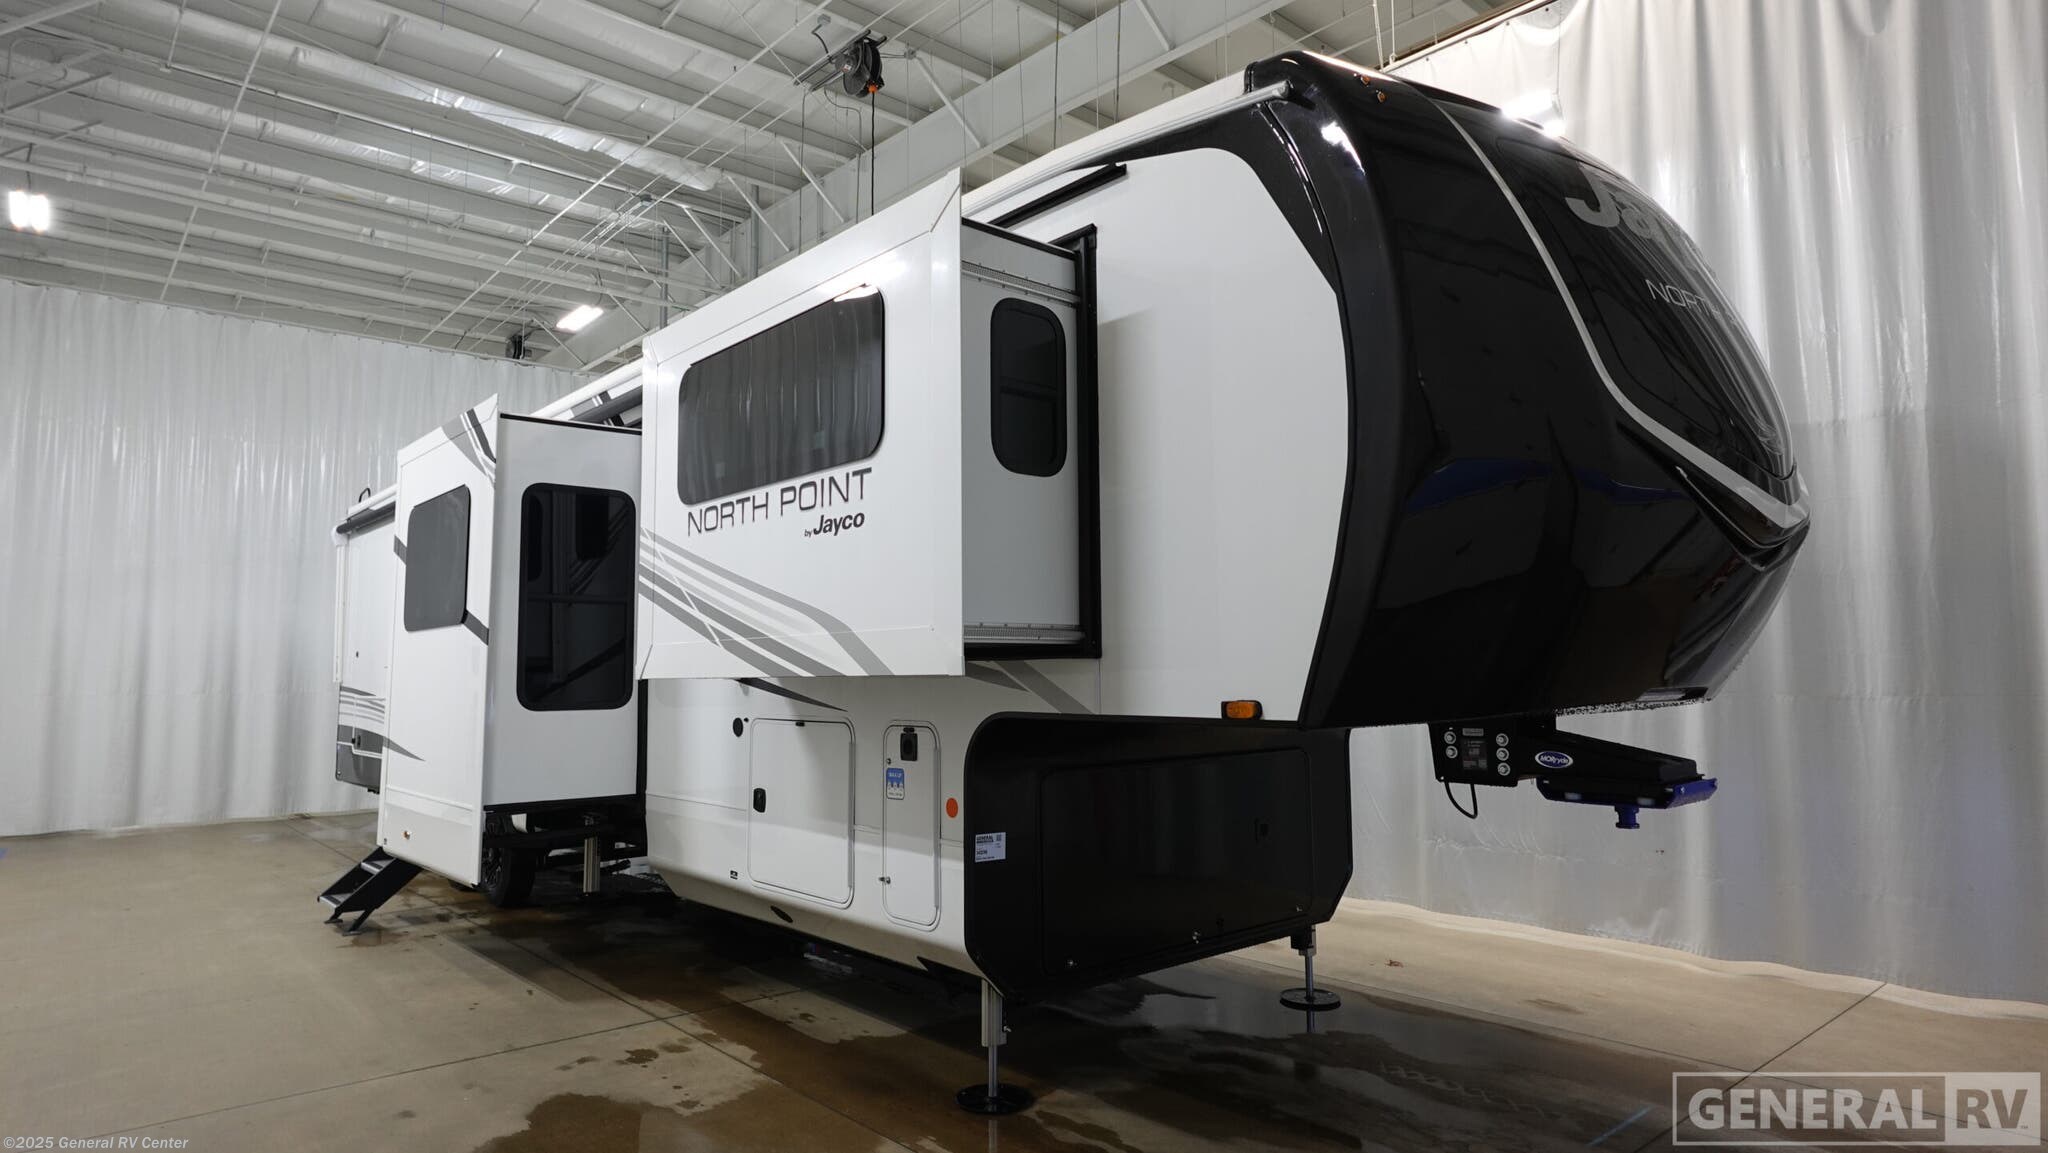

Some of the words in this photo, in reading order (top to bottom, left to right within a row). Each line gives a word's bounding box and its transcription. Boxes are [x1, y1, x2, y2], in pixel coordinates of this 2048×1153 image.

[688, 491, 769, 537] NORTH
[780, 467, 872, 517] POINT
[804, 529, 812, 538] by
[813, 512, 866, 536] Jayco
